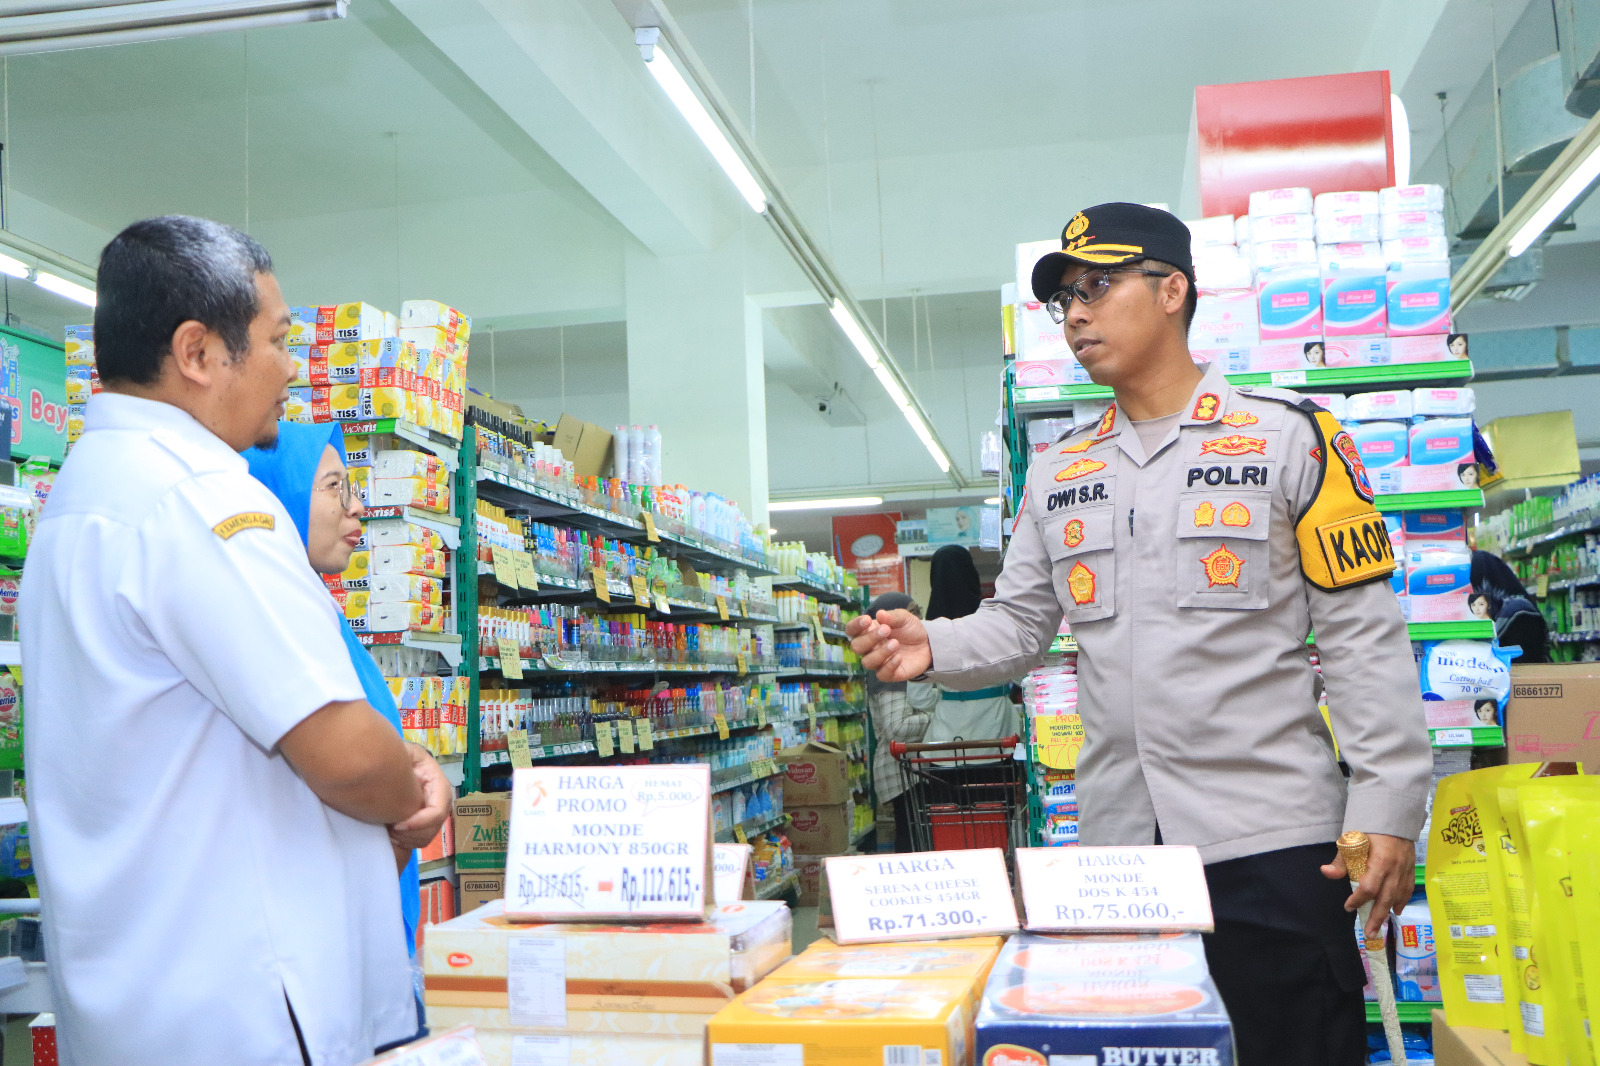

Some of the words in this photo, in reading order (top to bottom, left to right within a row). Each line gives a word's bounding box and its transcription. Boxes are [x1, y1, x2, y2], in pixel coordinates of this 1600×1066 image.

[1200, 322, 1244, 332] modern
[1188, 465, 1268, 488] POLRI
[1047, 485, 1076, 511] DWI
[1078, 482, 1109, 503] S.R.
[1449, 673, 1476, 683] Cotton
[1477, 677, 1493, 686] ball
[1461, 685, 1471, 693] 70
[1515, 686, 1560, 696] 68661377
[558, 775, 625, 790] HARGA
[644, 780, 682, 788] HEMAT
[556, 798, 628, 813] PROMO
[571, 823, 644, 837] MONDE
[525, 842, 623, 855] HARMONY
[628, 842, 690, 855] 850GR
[878, 857, 955, 875] HARGA
[1077, 854, 1146, 867] HARGA
[1084, 872, 1144, 884] MONDE
[865, 882, 922, 896] SERENA
[925, 878, 980, 890] CHEESE
[1078, 887, 1113, 898] DOS
[1115, 886, 1128, 898] K
[1131, 886, 1159, 897] 454
[869, 894, 934, 909] COOKIES
[936, 890, 981, 903] 454GR
[1055, 902, 1185, 923] Rp.75.060,-
[868, 909, 988, 933] Rp.71.300,-
[1423, 924, 1436, 952] mitu
[1101, 1046, 1220, 1066] BUTTER
